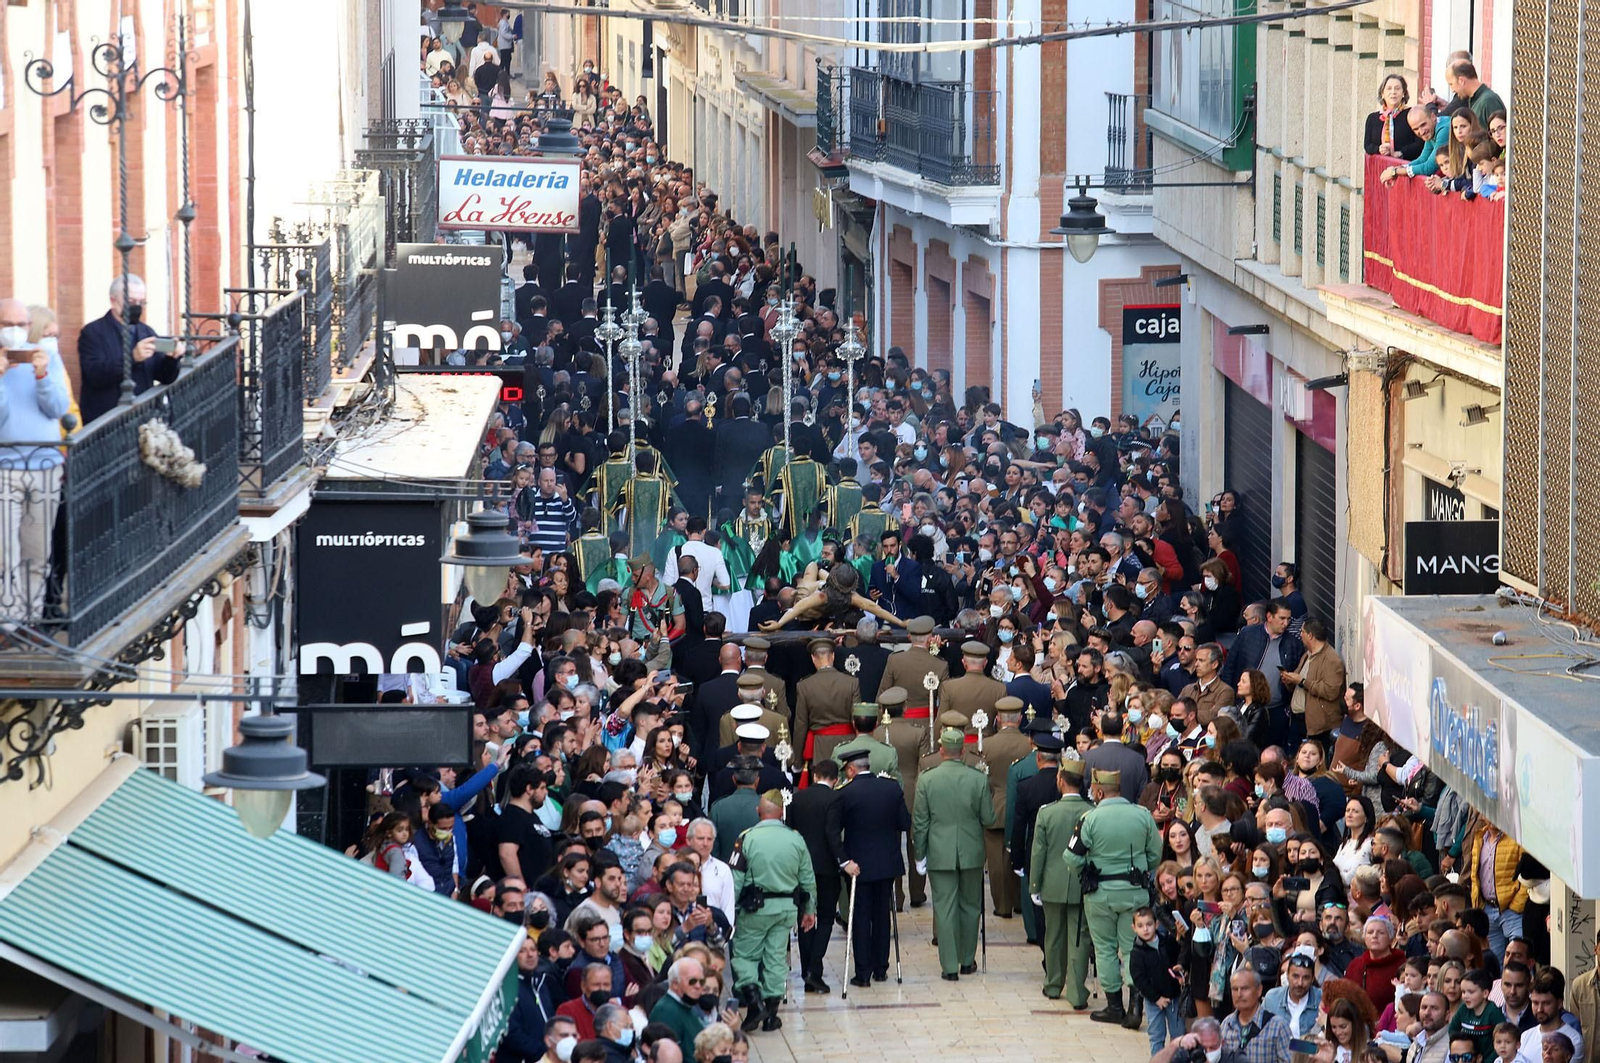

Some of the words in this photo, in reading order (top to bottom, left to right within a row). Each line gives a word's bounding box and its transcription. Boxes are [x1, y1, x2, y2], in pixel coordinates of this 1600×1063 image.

[453, 168, 569, 189] Heladeria
[443, 193, 484, 222] La
[1135, 313, 1180, 338] caja
[1145, 379, 1180, 402] Caja
[1431, 488, 1466, 521] MANGO
